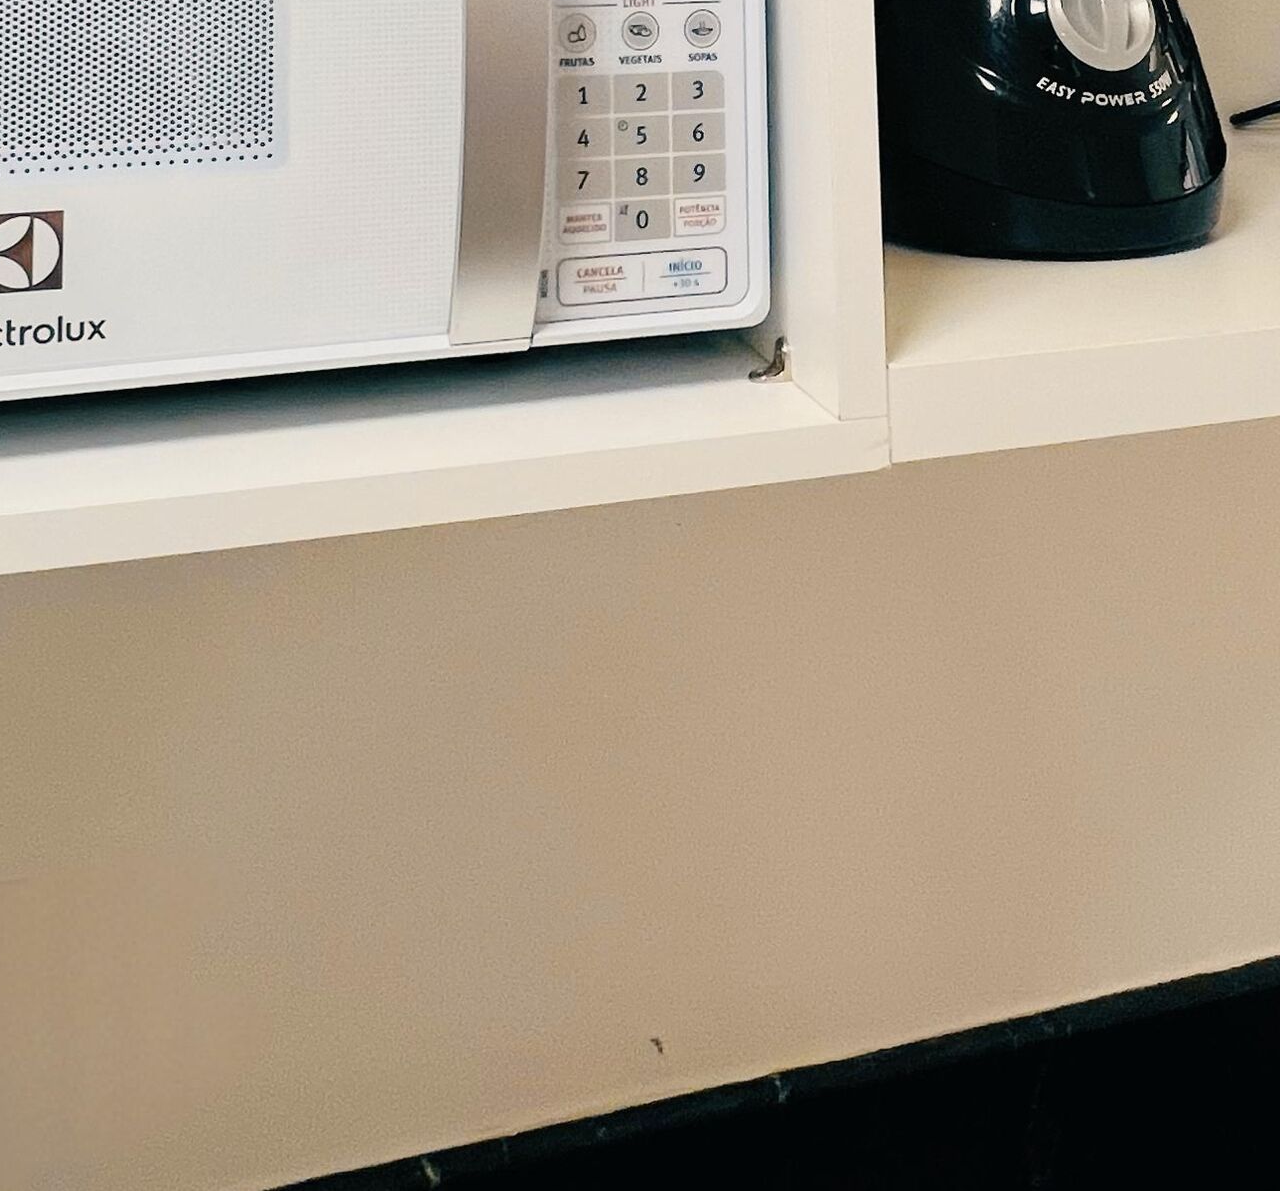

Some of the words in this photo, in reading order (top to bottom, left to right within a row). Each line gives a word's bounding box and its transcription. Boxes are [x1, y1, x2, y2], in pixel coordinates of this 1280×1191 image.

[559, 57, 595, 67] FRUTAS
[619, 54, 662, 65] VEGETAIS
[688, 52, 718, 62] SOPAS
[578, 87, 588, 104] 1
[636, 83, 647, 102] 2
[692, 80, 704, 99] 3
[1036, 76, 1076, 100] EASY
[1081, 90, 1148, 106] POWER
[577, 129, 590, 147] 4
[636, 126, 647, 144] 5
[692, 123, 705, 142] 6
[578, 171, 589, 190] 7
[636, 167, 648, 186] 8
[693, 163, 706, 182] 9
[636, 210, 648, 229] 0
[577, 266, 623, 279] CANCELA
[669, 259, 702, 272] INÍCIO
[583, 283, 617, 294] PAUSA
